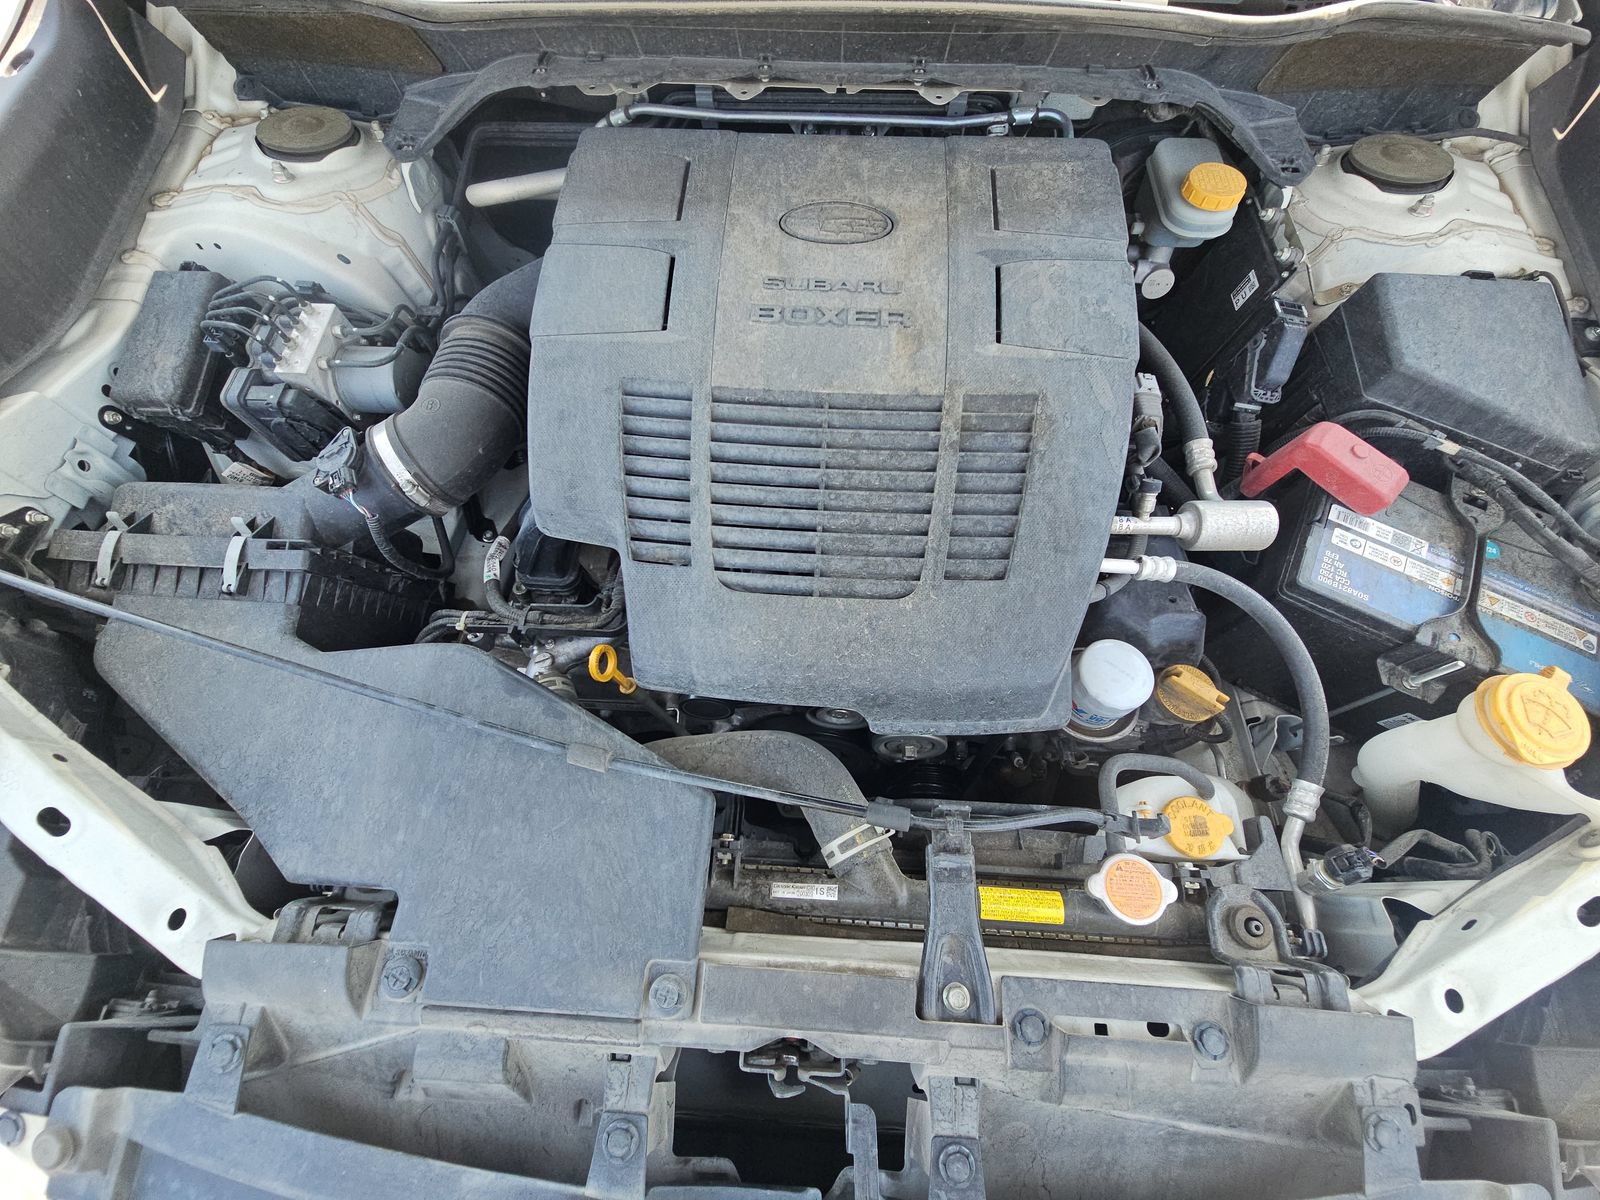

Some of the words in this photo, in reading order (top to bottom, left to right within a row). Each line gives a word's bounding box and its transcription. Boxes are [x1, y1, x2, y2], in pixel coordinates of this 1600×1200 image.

[762, 277, 903, 294] SUBARU
[750, 303, 912, 329] BOXER
[1167, 799, 1216, 819] COOLANT
